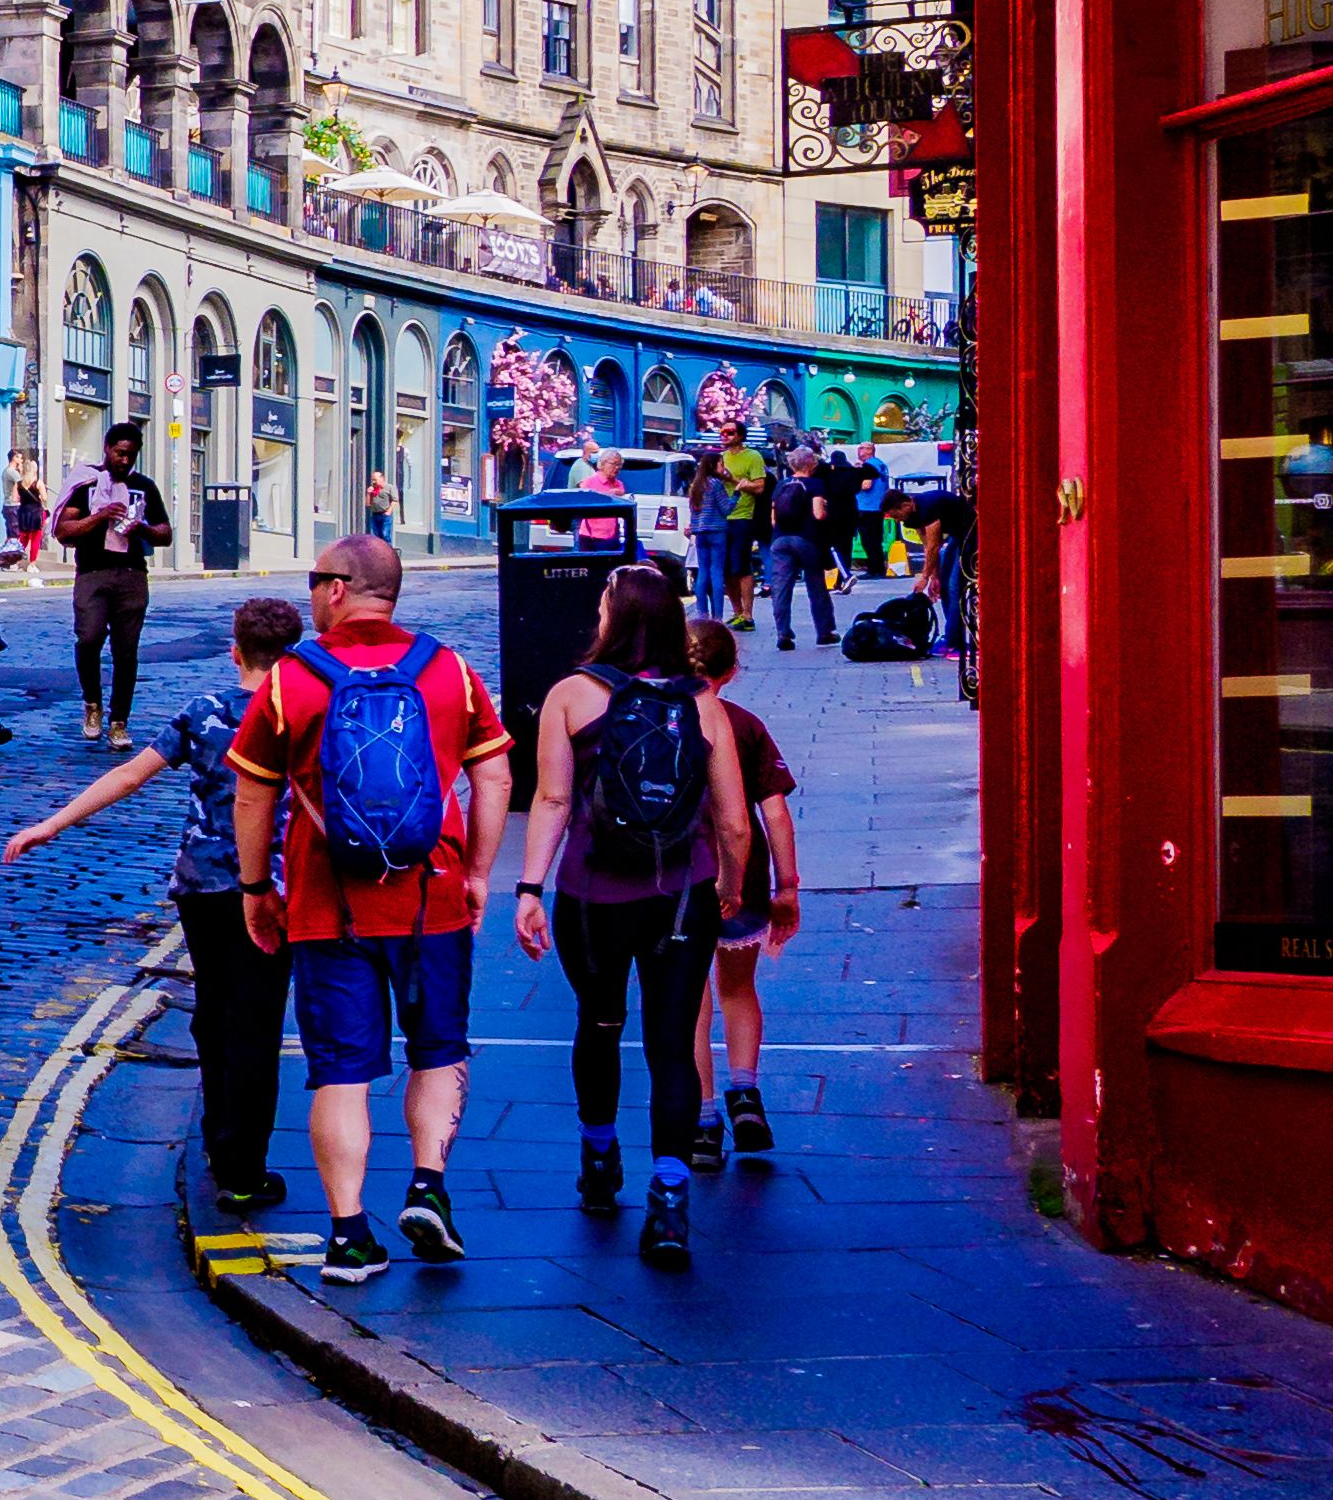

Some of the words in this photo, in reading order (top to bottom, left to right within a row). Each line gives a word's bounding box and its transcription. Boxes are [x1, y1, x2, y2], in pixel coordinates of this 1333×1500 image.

[928, 223, 956, 234] FREE
[542, 567, 589, 579] LITTER
[1281, 937, 1321, 959] REAL
